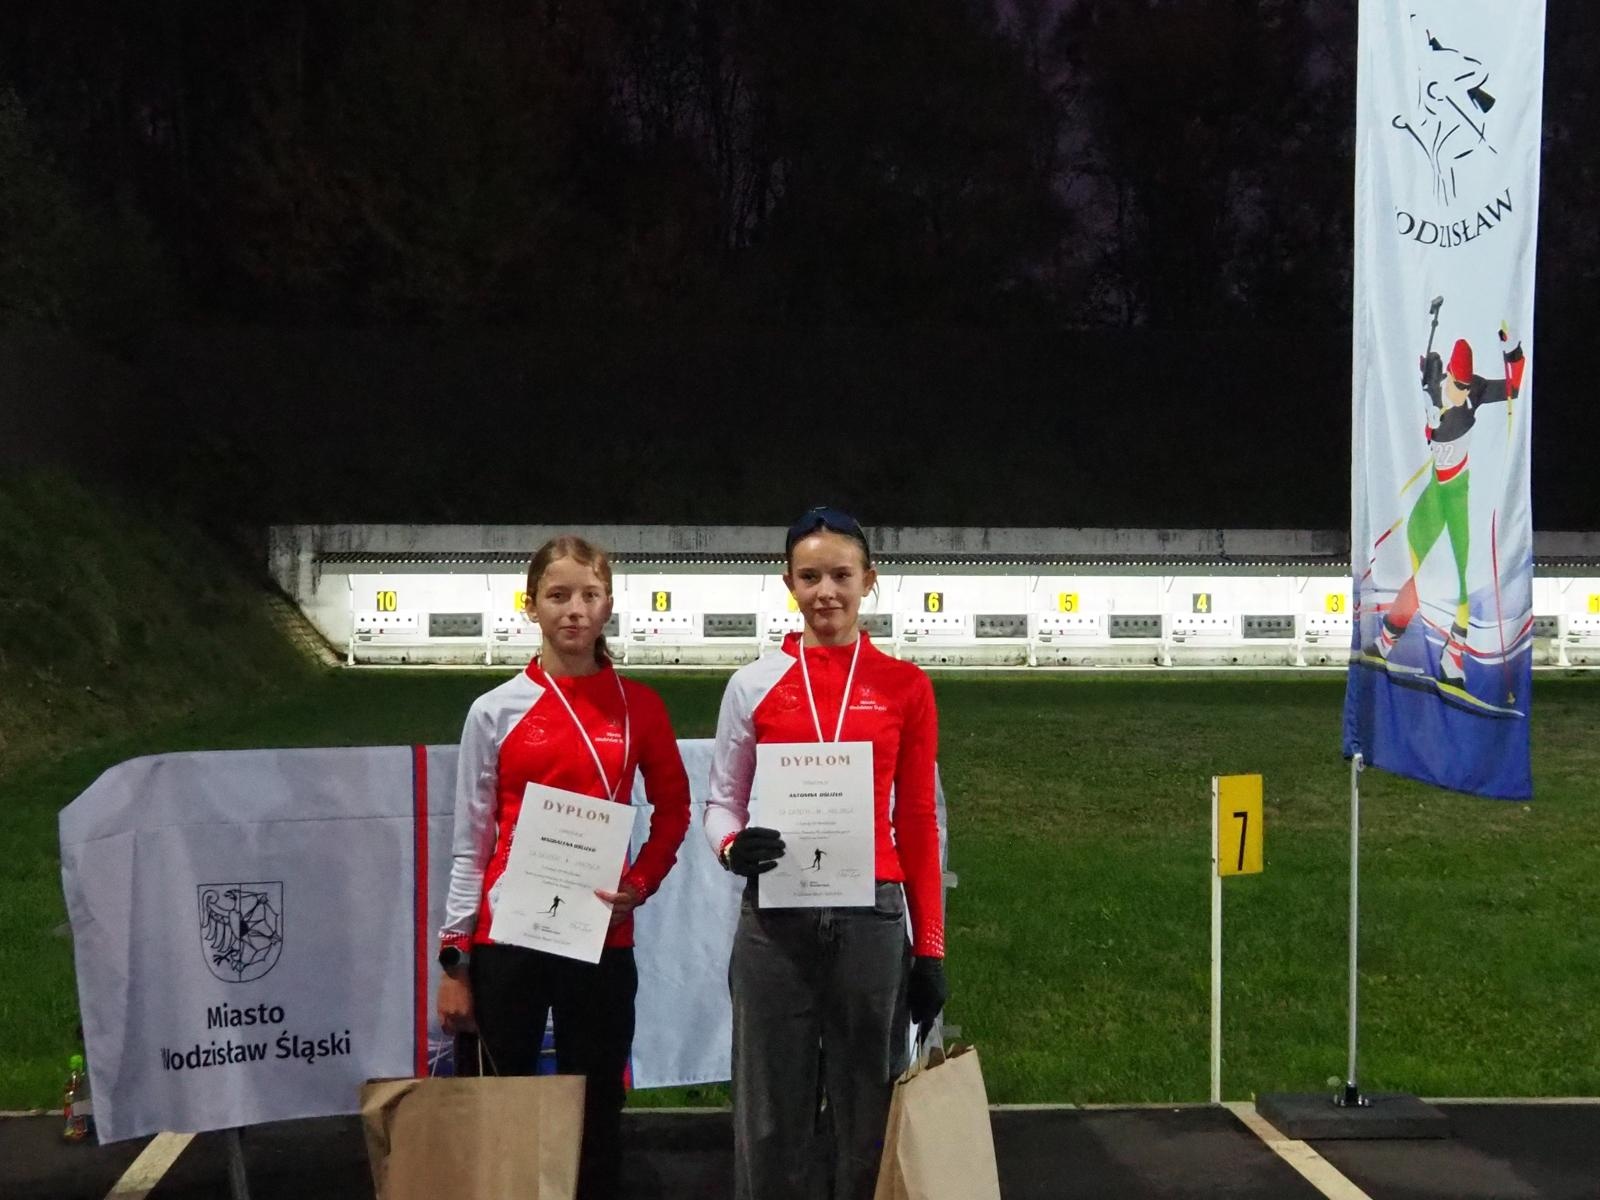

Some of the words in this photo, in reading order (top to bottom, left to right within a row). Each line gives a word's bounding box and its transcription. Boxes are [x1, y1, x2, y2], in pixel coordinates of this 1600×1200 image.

[1395, 187, 1513, 248] ODZISŁAW
[377, 591, 397, 611] 10
[656, 592, 667, 611] 8
[928, 593, 939, 611] 6
[1065, 594, 1073, 611] 5
[1196, 594, 1208, 612] 4
[1331, 595, 1340, 612] 3
[780, 755, 851, 767] DYPLOM
[542, 799, 611, 824] DYPLOM
[1233, 812, 1247, 870] 7
[207, 1003, 285, 1030] Miasto
[275, 1030, 350, 1064] Śląski
